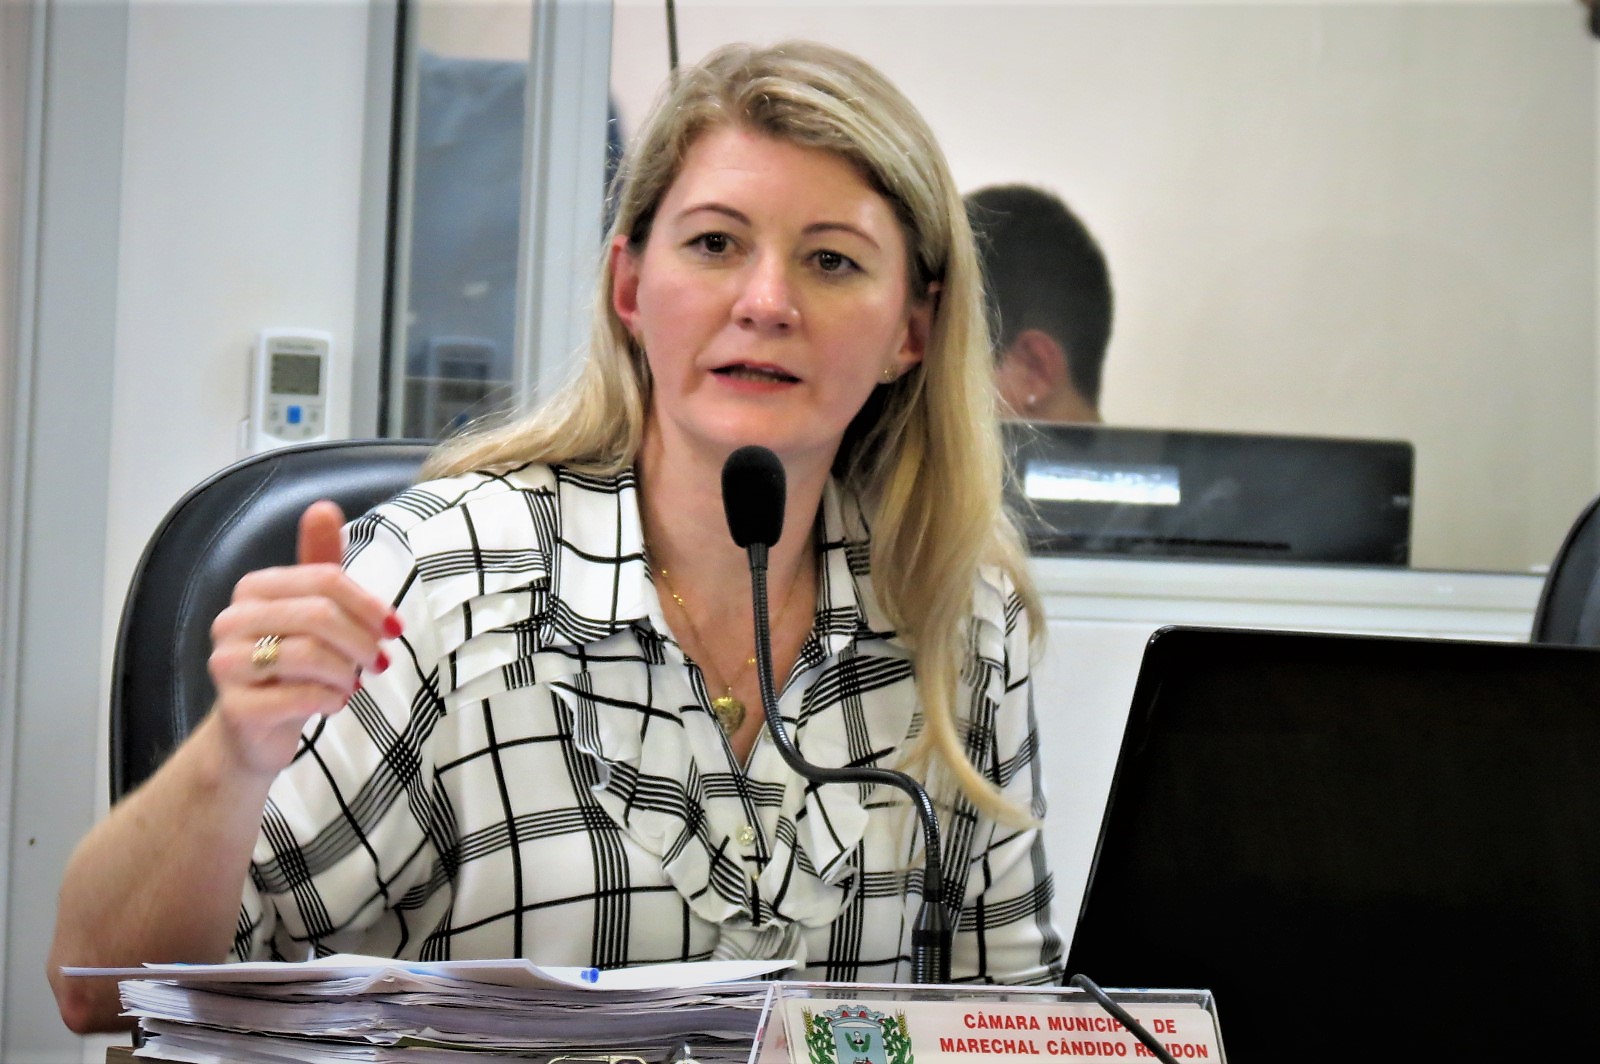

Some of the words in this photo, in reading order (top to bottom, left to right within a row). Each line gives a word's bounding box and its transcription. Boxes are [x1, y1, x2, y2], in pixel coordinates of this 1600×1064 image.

[963, 1010, 1041, 1030] CÂMARA
[1047, 1016, 1144, 1034] MUNICIP
[1153, 1018, 1177, 1034] DE
[939, 1037, 1041, 1055] MARECHAL
[1046, 1038, 1127, 1057] CÂNDIDO
